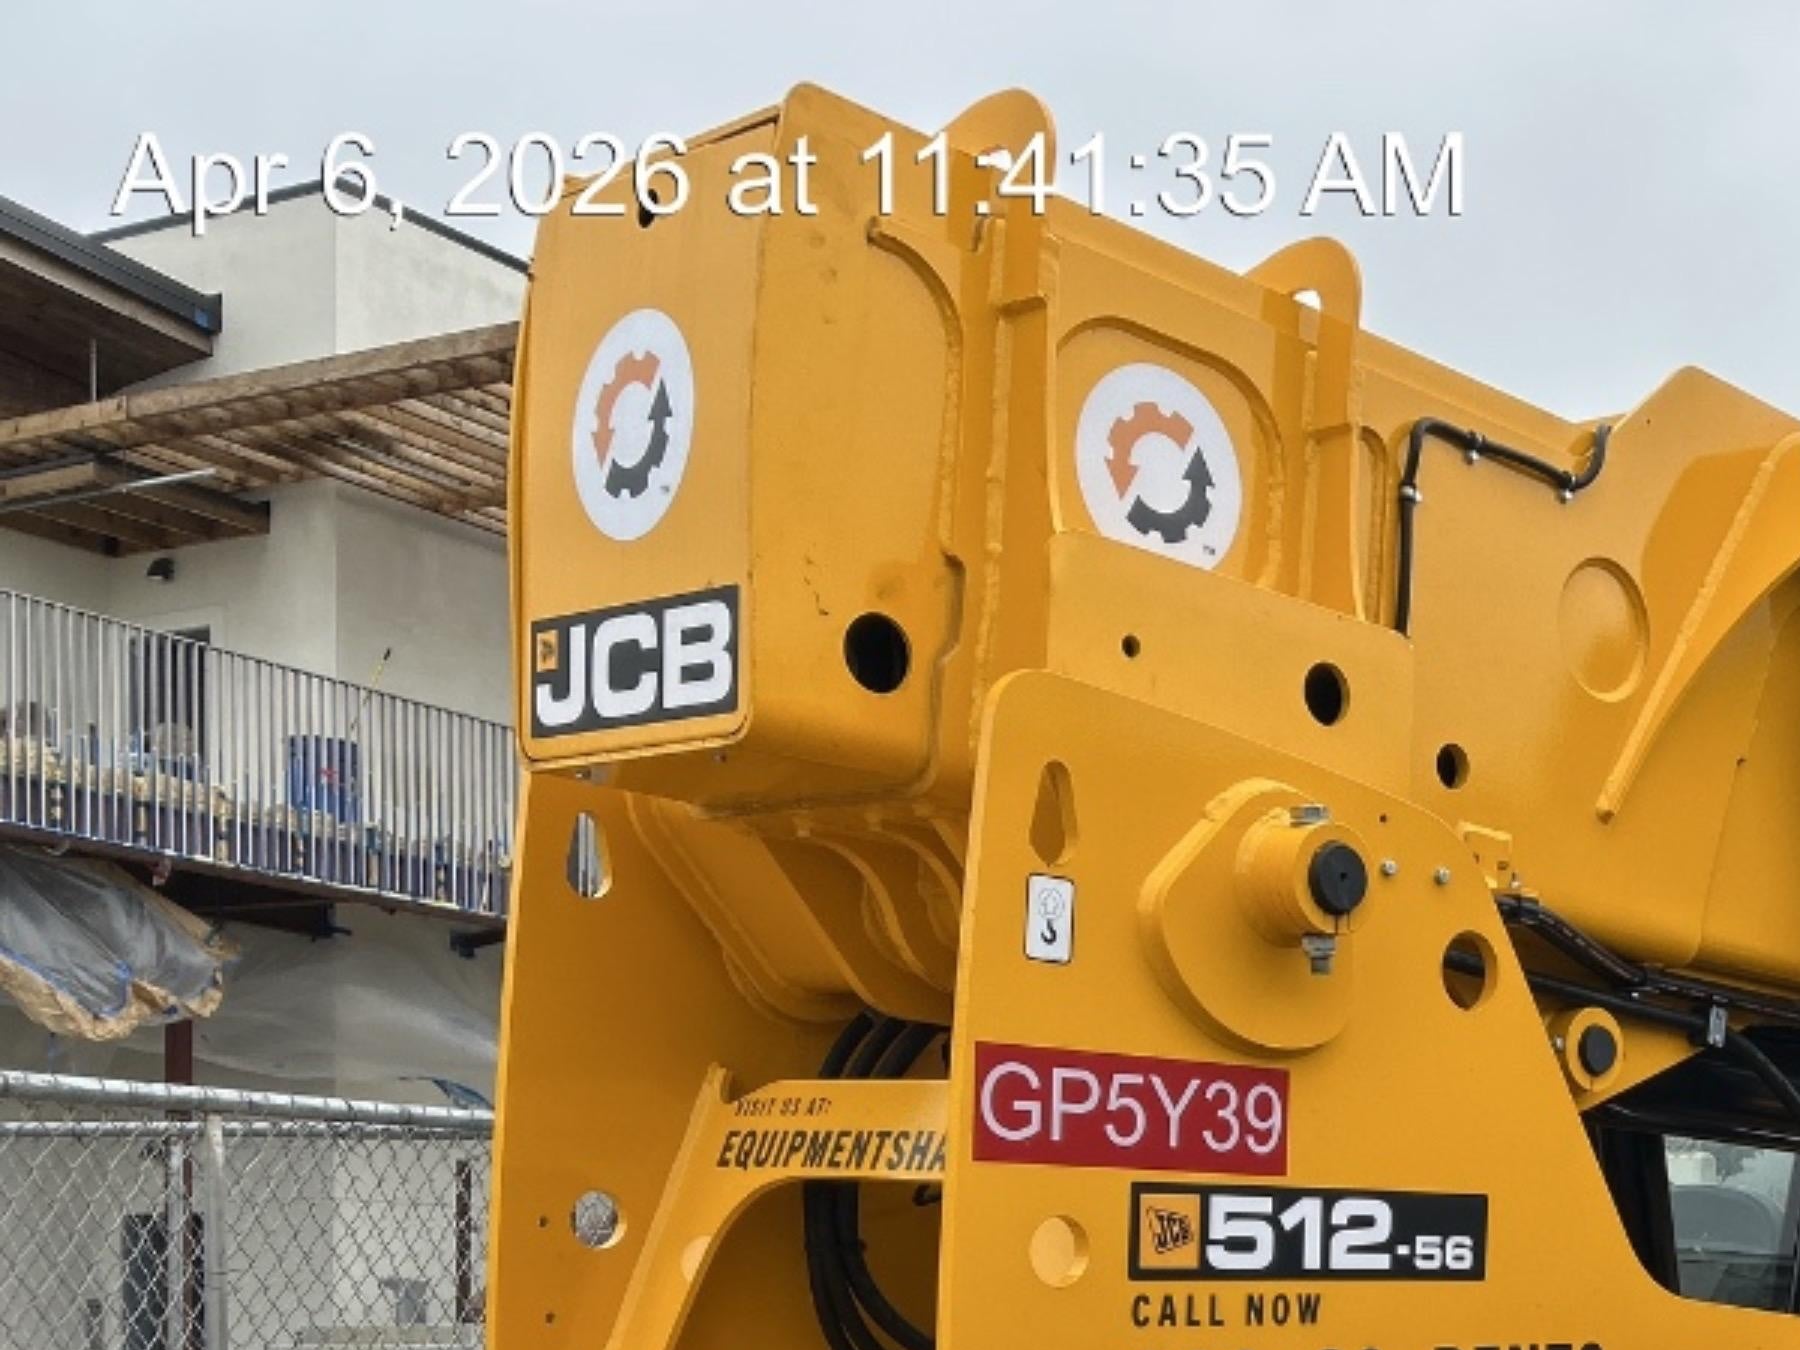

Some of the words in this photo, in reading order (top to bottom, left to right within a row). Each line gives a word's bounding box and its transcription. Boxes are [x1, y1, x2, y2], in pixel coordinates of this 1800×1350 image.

[535, 600, 733, 727] JCB
[980, 1061, 1284, 1154] GP5Y39
[1205, 1193, 1475, 1271] 512-56
[1131, 1294, 1226, 1328] CALL
[1244, 1293, 1323, 1327] NOW
